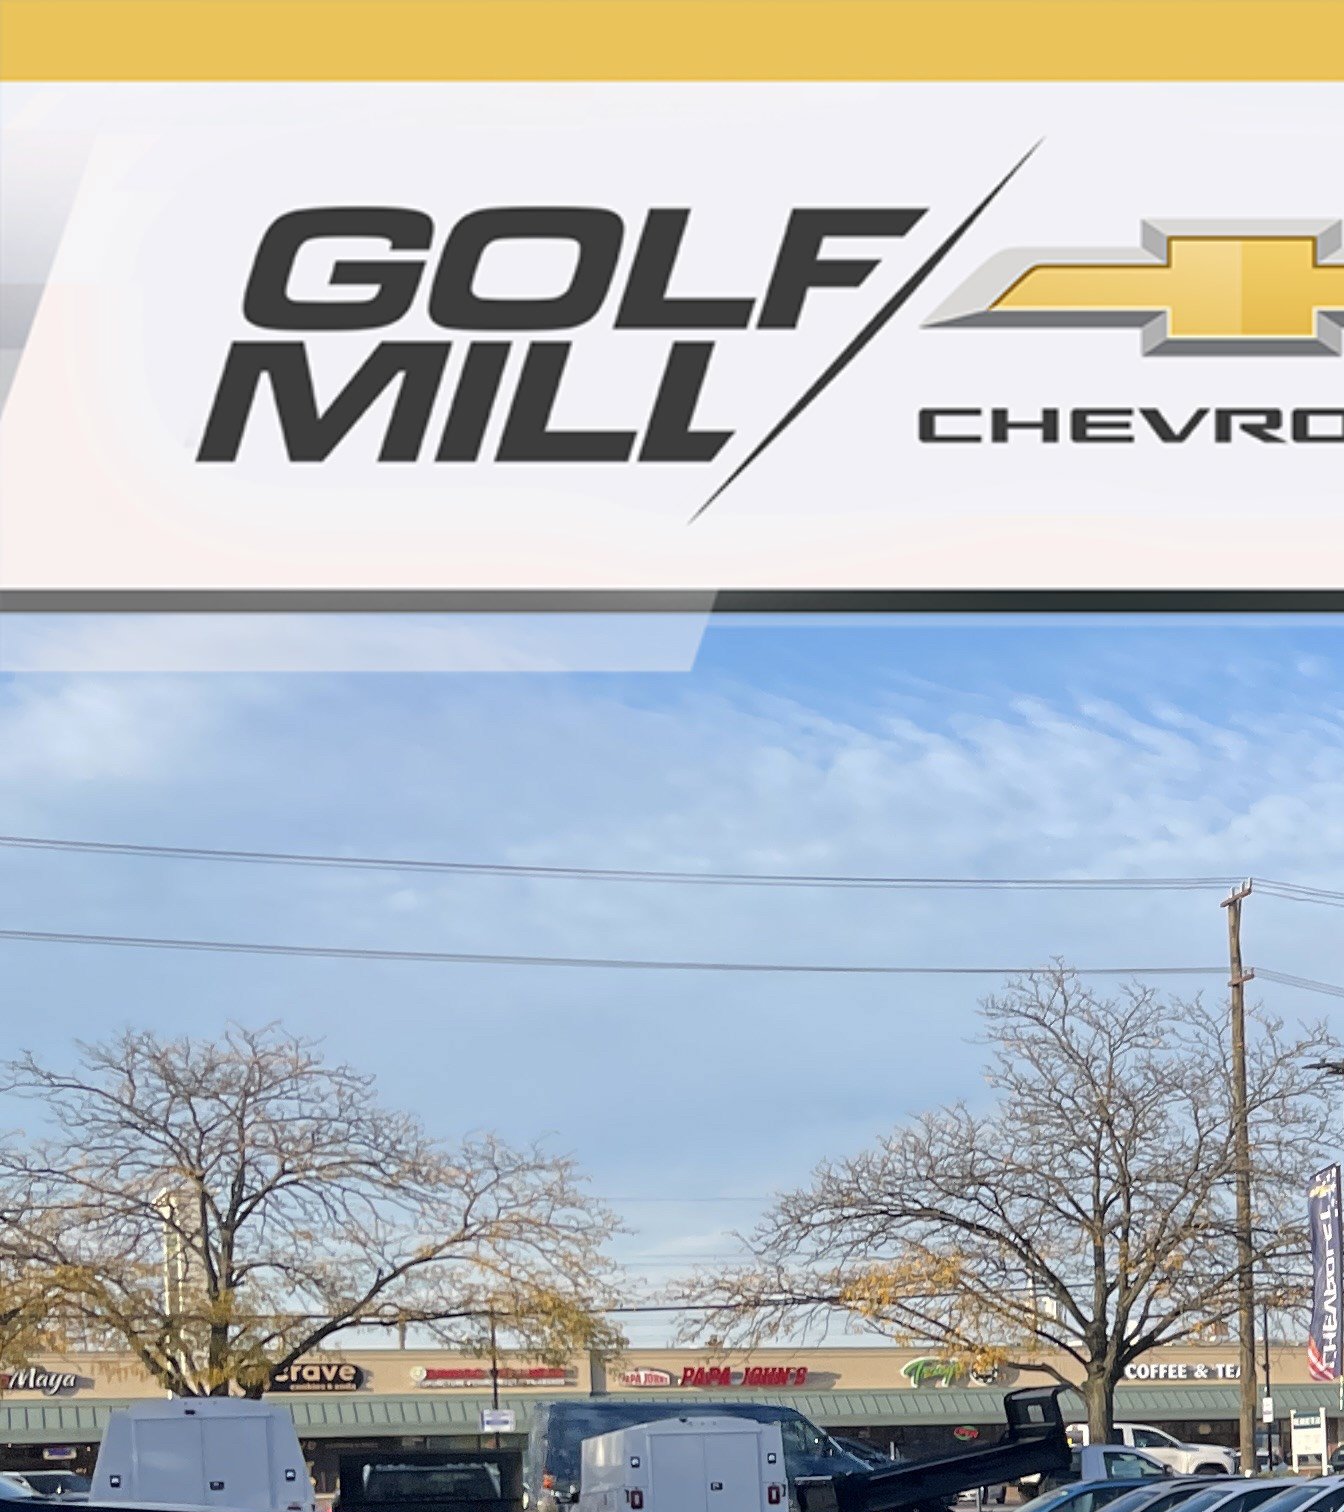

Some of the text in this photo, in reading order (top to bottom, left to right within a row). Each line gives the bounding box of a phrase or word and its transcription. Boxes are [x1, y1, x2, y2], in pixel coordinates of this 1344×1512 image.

[681, 1367, 730, 1386] PAPA
[1124, 1363, 1187, 1379] COFFEE
[1194, 1363, 1208, 1378] &
[8, 1367, 76, 1395] Maya
